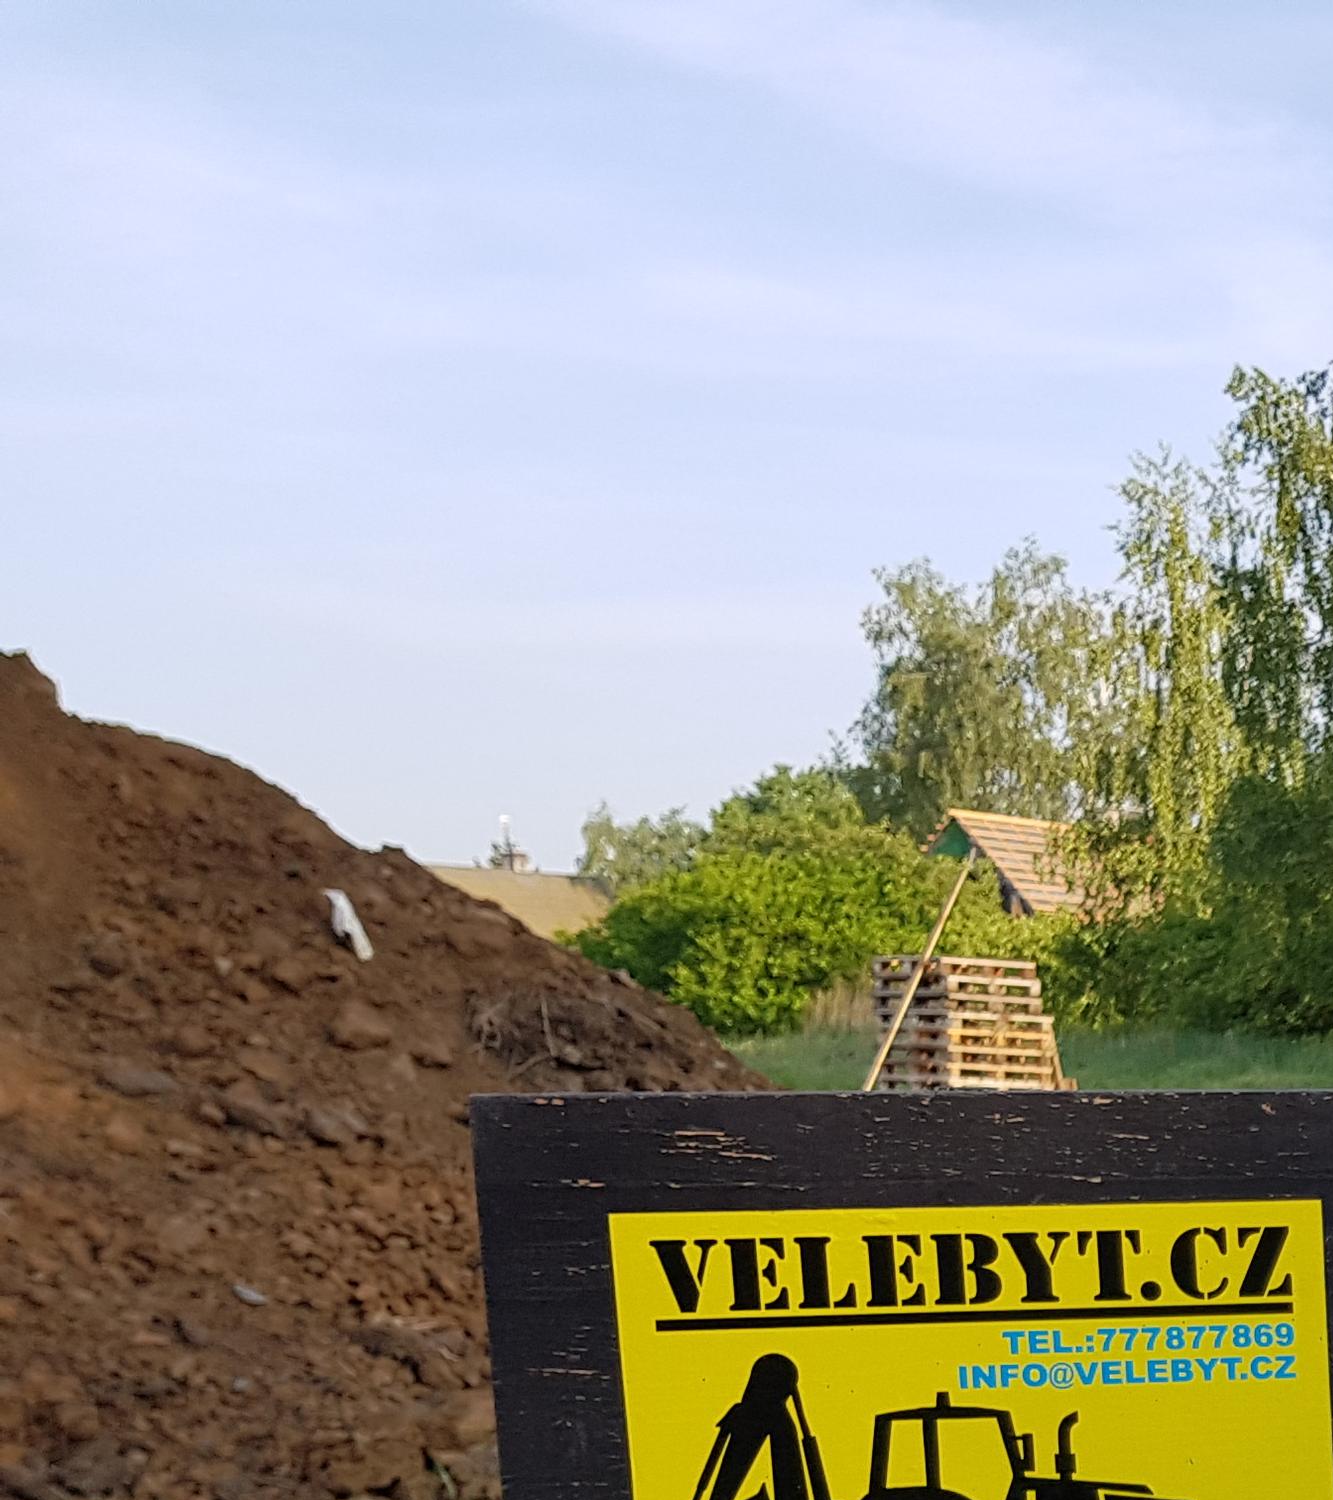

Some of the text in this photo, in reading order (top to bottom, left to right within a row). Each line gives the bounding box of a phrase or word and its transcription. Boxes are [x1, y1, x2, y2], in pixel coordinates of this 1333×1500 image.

[650, 1225, 1293, 1313] VELEBYT.CZ
[1002, 1323, 1295, 1356] TEL.:777877869
[959, 1355, 1296, 1389] INFO@VELEBYT.CZ
